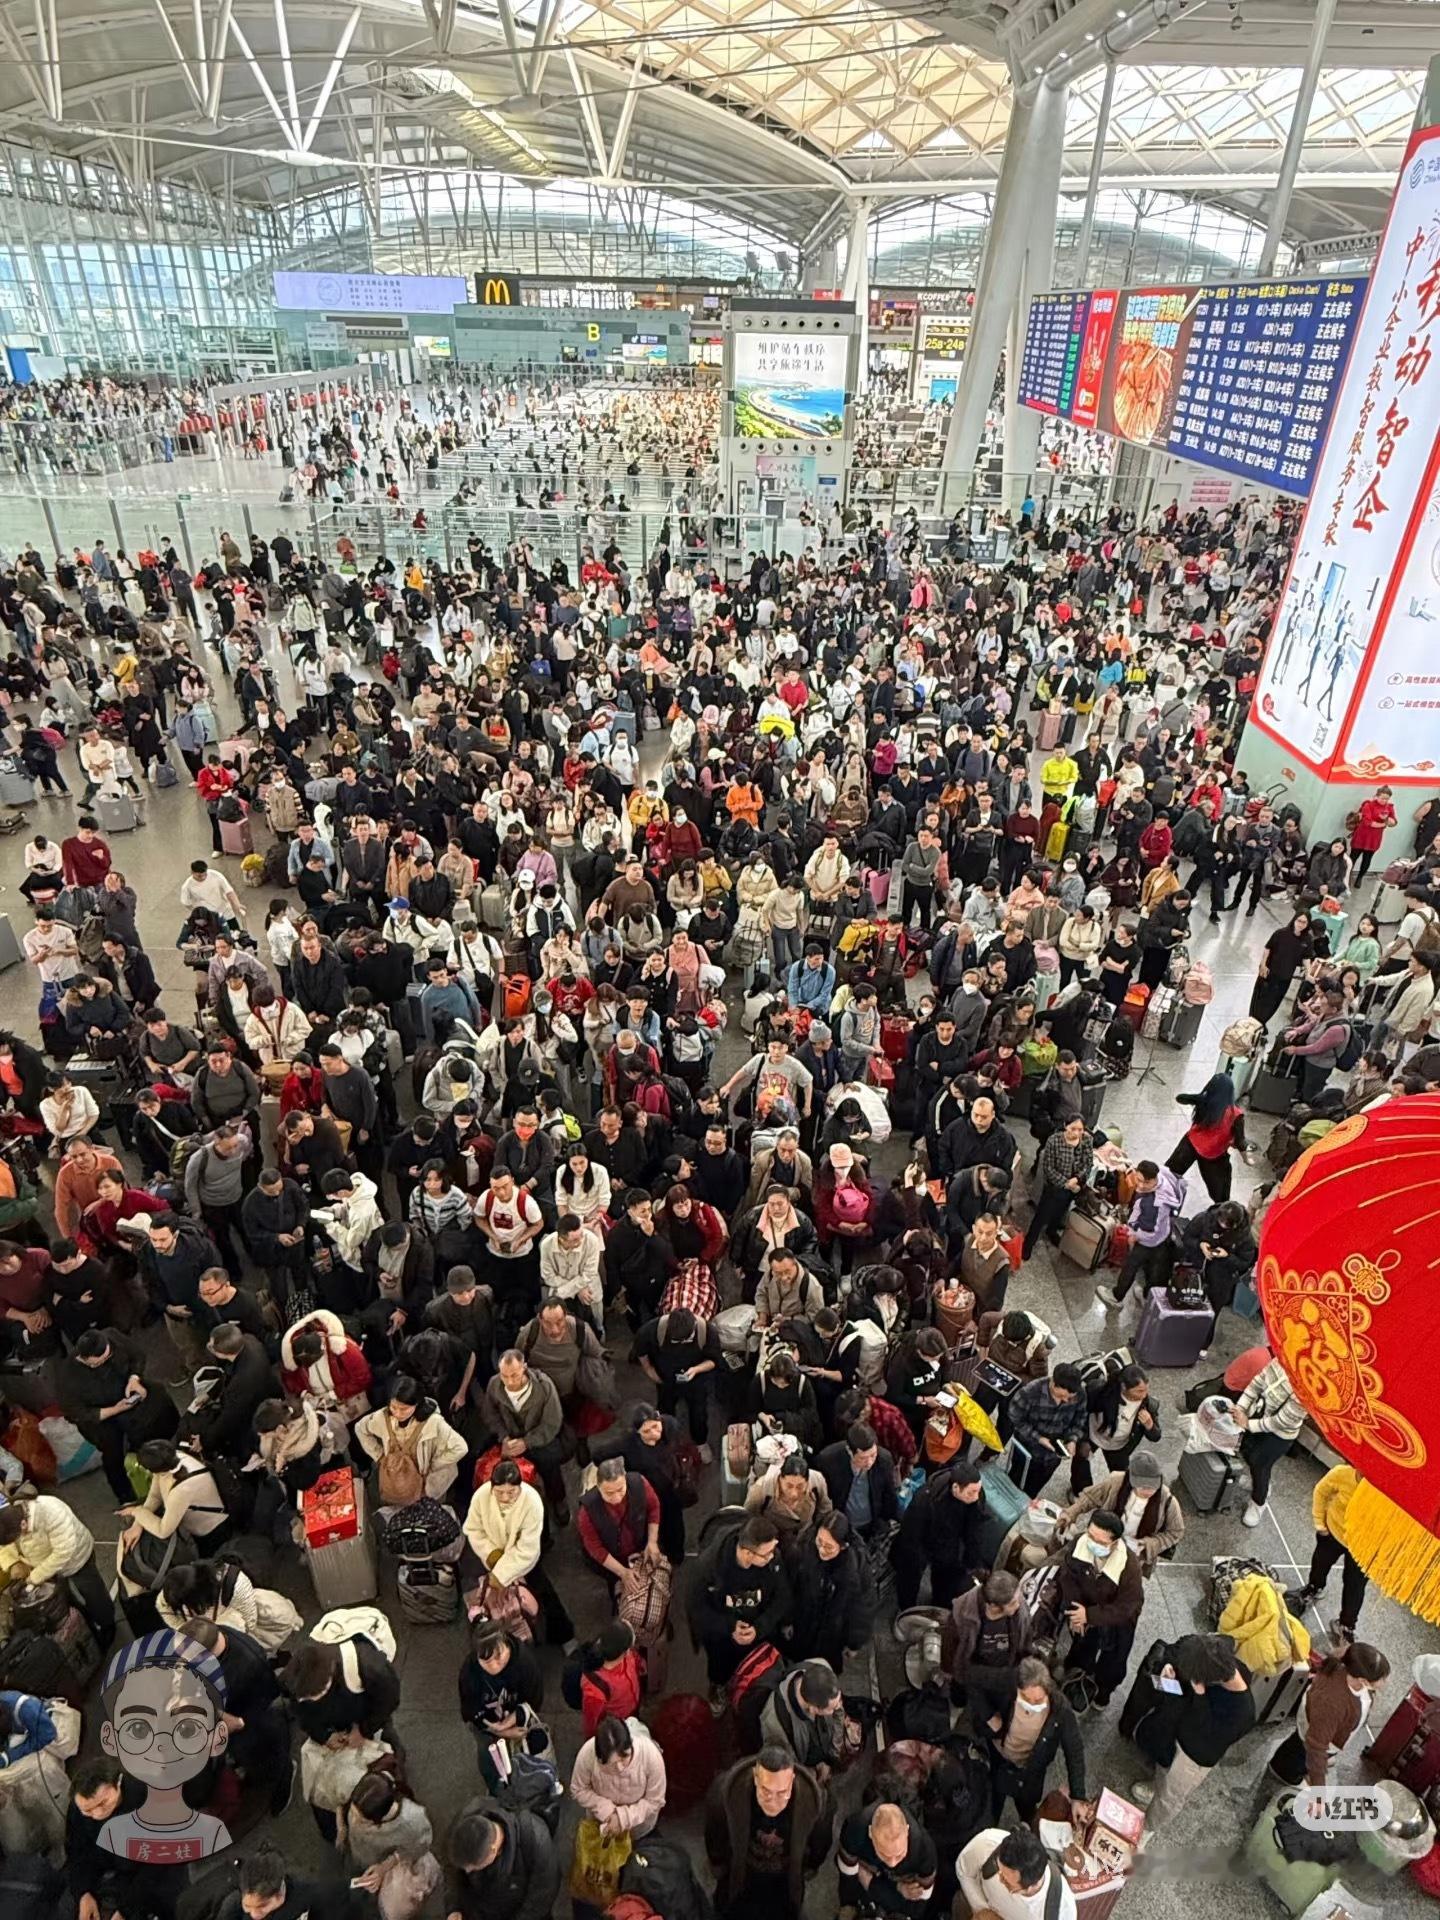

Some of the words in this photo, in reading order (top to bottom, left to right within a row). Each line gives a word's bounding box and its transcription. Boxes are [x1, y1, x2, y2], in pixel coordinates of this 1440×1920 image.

[575, 281, 617, 291] McDonald's
[1321, 302, 1352, 318] 正在候车
[587, 322, 600, 341] B
[1315, 323, 1346, 340] 正在候车
[1310, 344, 1341, 360] 正在候车
[1305, 363, 1335, 381] 正在候车
[1300, 384, 1329, 402] 正在候车
[1322, 226, 1426, 547] 中小企业数智服务专家
[1294, 404, 1324, 423] 正在候车
[1289, 423, 1318, 442] 正在候车
[1284, 442, 1313, 462] 正在候车
[1280, 460, 1308, 480] 正在候车
[1281, 1297, 1349, 1411] 福
